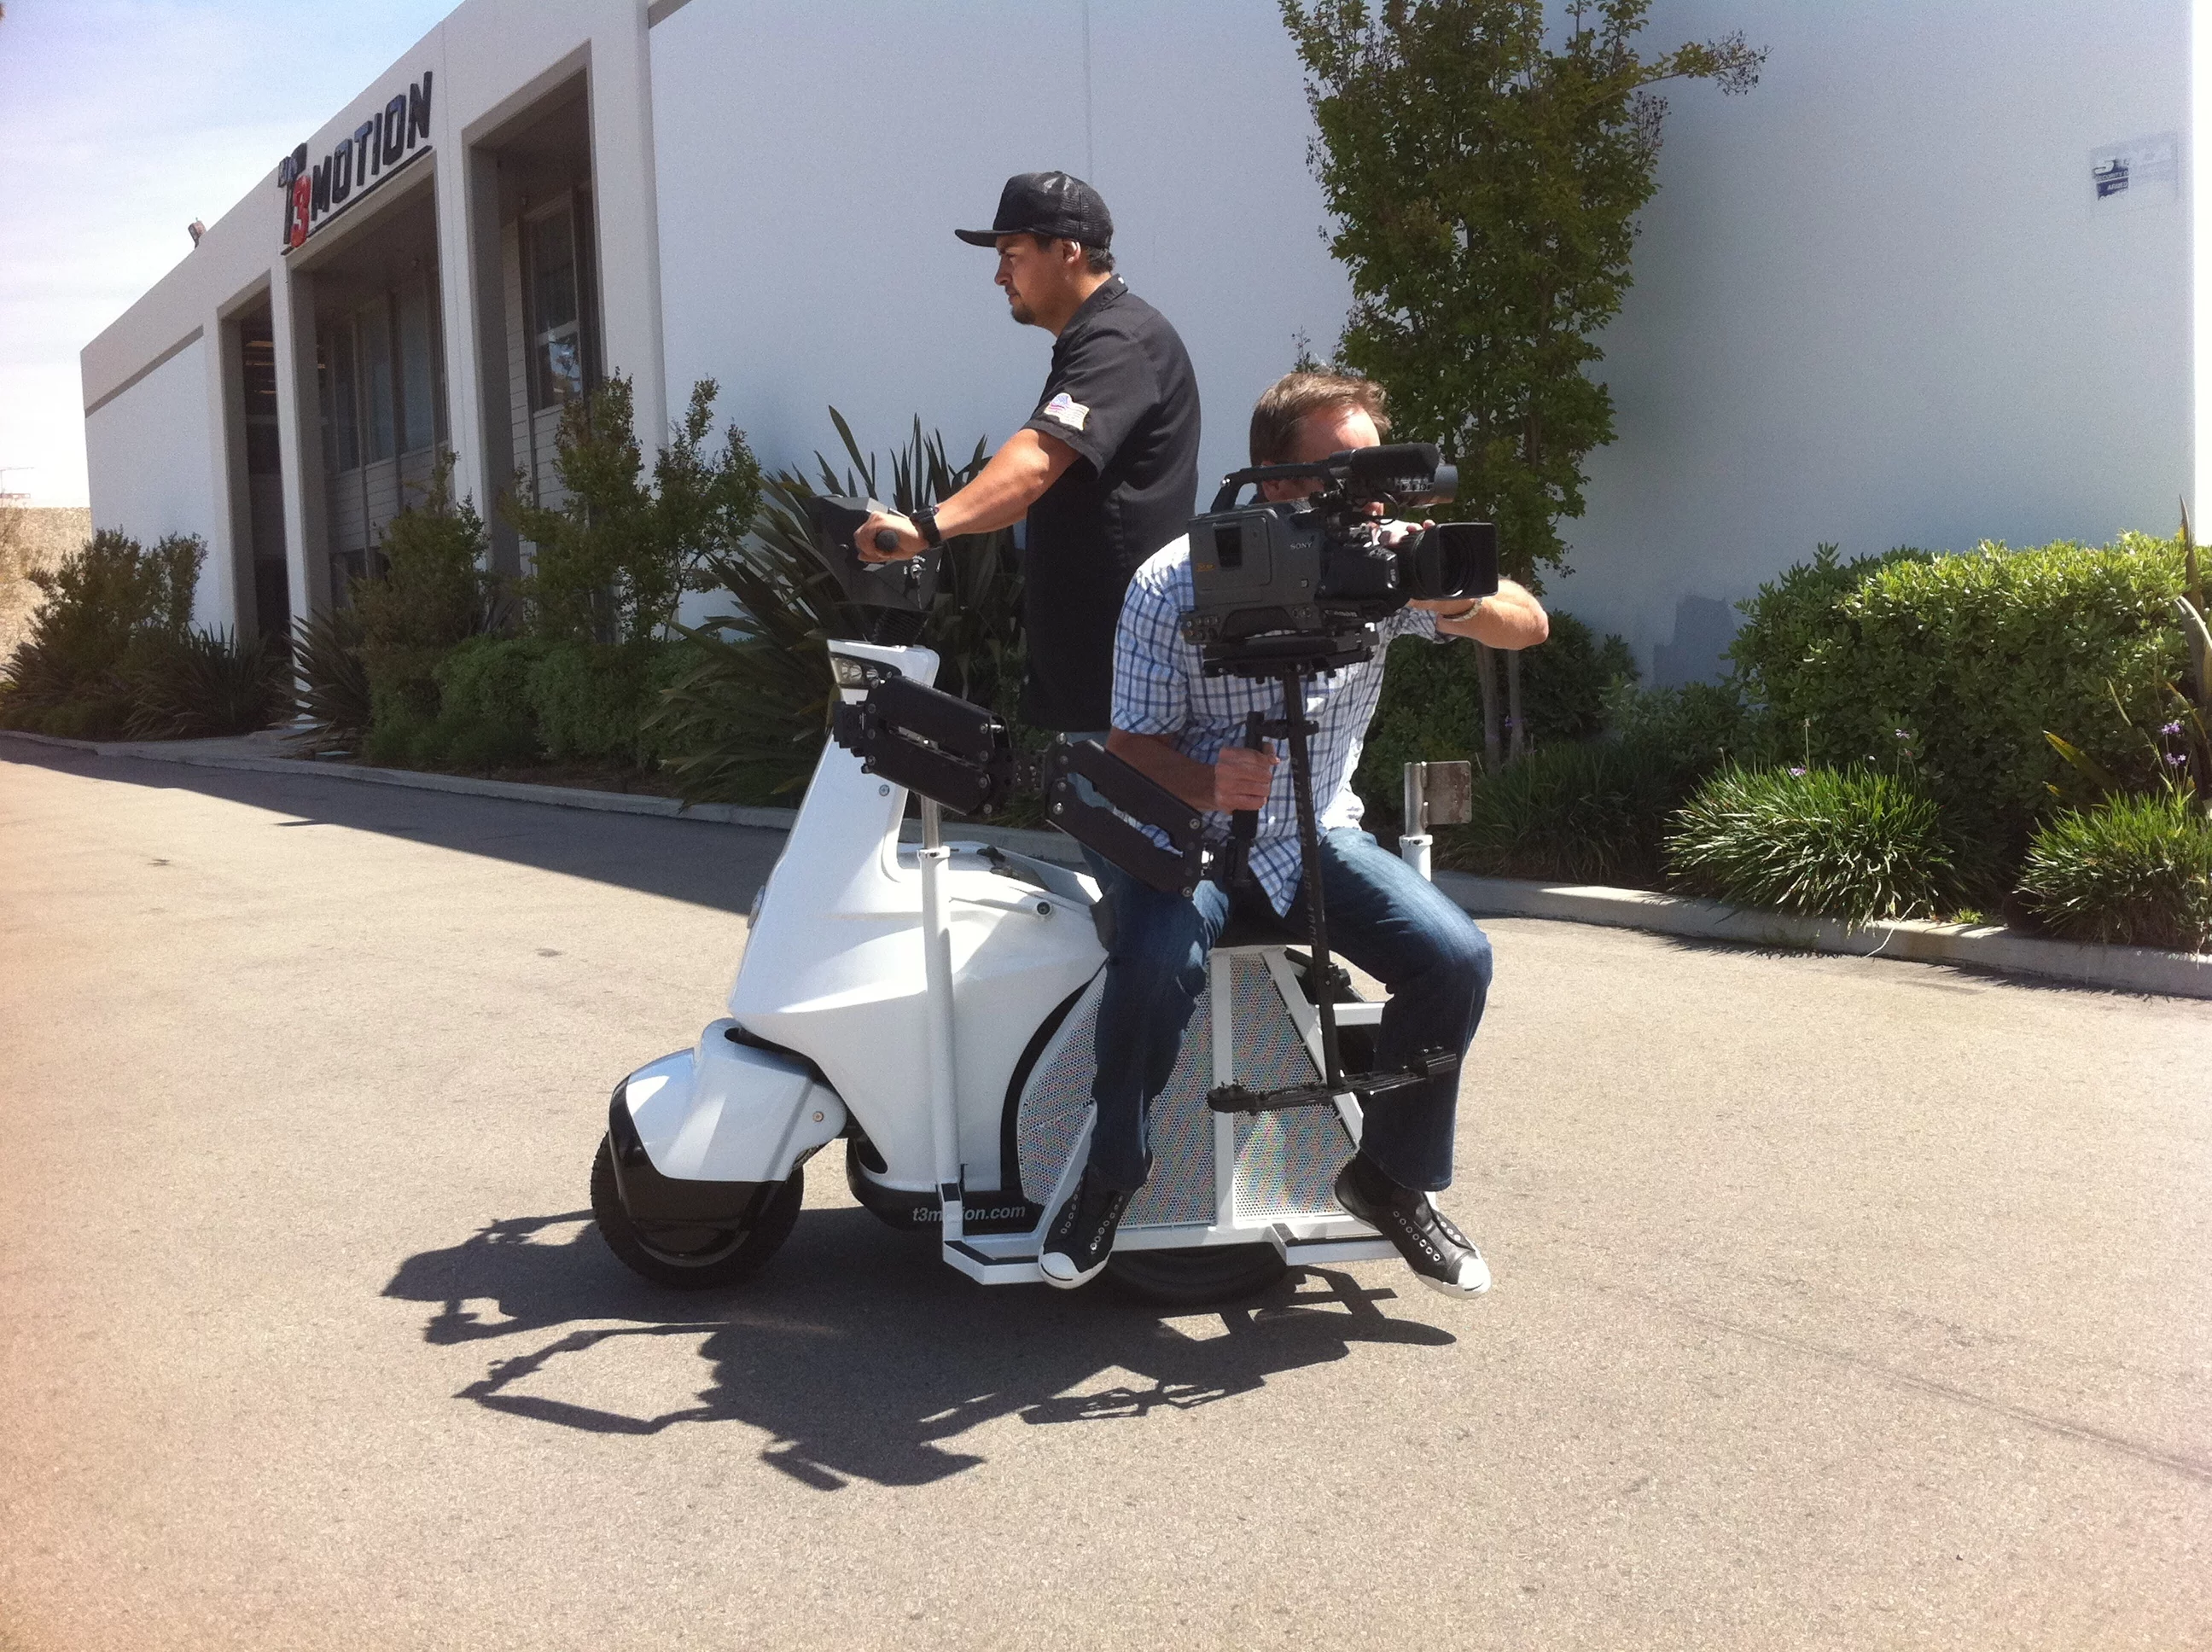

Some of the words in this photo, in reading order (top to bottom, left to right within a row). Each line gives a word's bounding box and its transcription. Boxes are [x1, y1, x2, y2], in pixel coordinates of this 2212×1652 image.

[311, 71, 433, 221] MOTION
[1289, 541, 1313, 550] SONY
[912, 1206, 1026, 1222] t3mon.com
